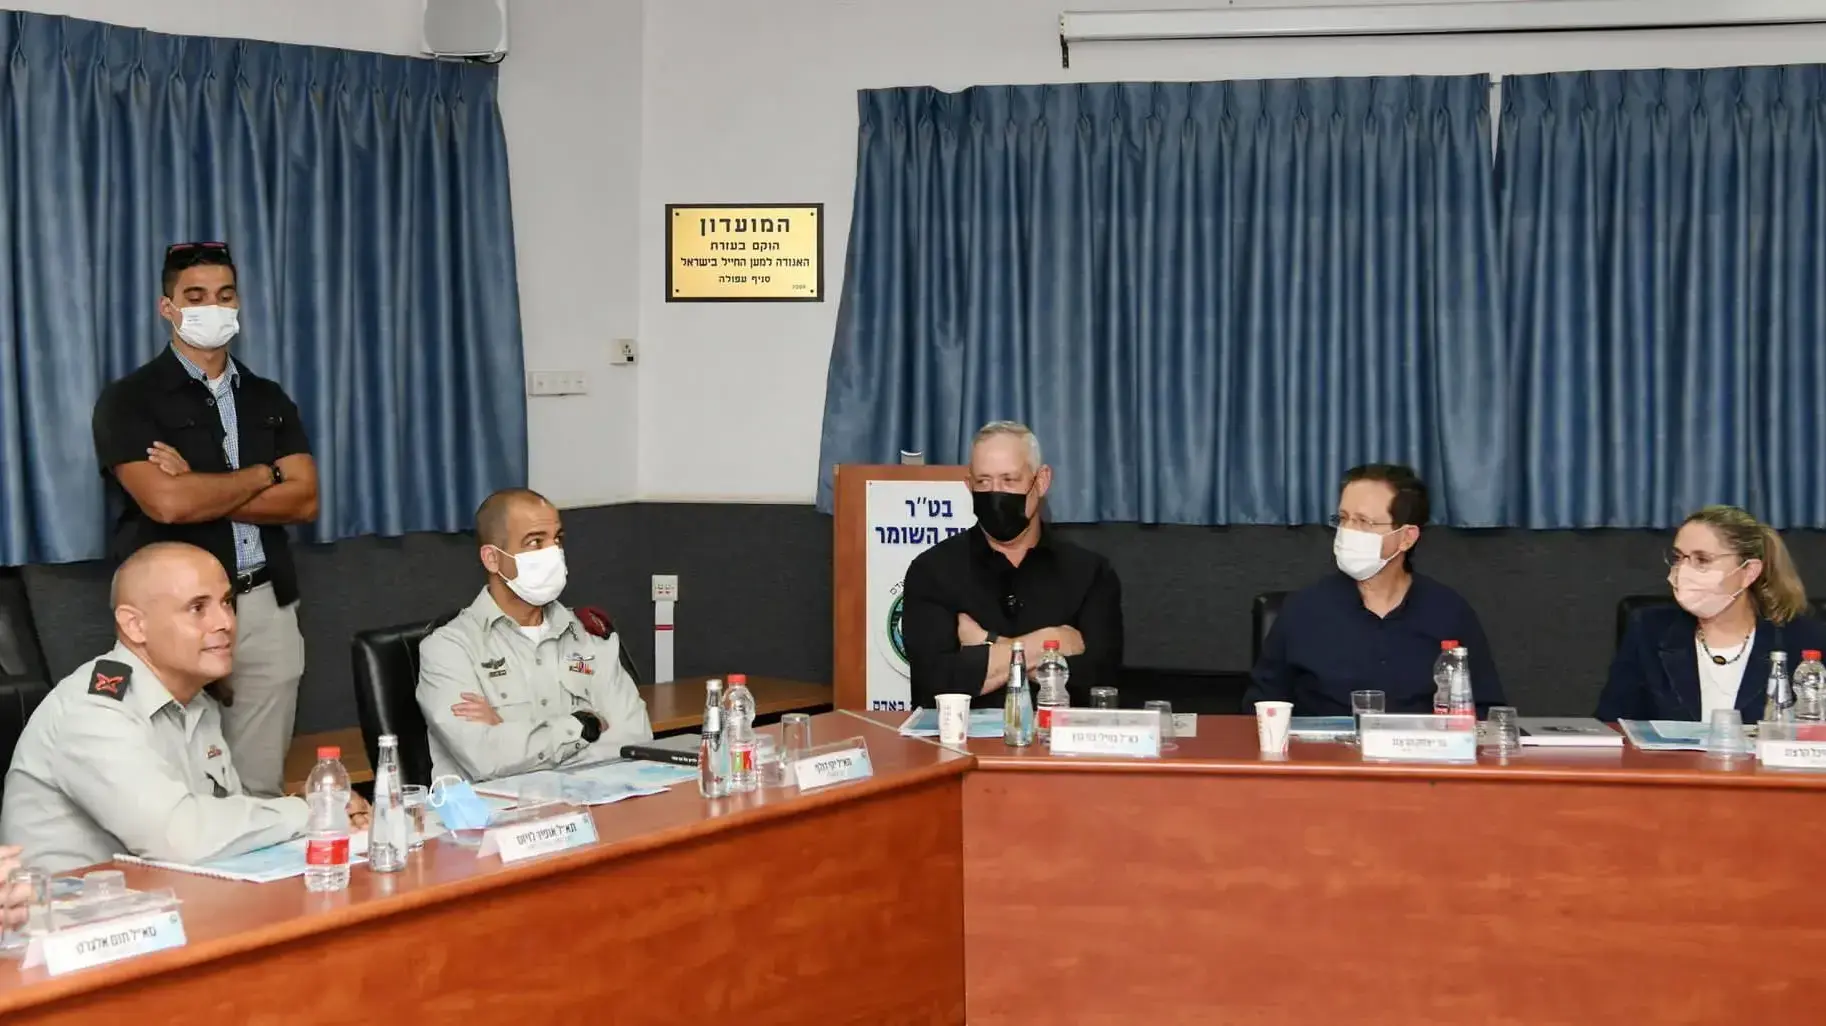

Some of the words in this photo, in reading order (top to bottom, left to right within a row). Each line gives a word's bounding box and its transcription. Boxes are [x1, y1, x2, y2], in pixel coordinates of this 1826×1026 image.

[700, 217, 790, 236] המועדון
[710, 241, 746, 251] בעזרת
[752, 241, 780, 253] הוקם
[680, 257, 718, 267] בישראל
[721, 257, 746, 267] החייל
[750, 257, 772, 269] למען
[776, 258, 810, 267] האגודה
[718, 275, 747, 284] עפולה
[751, 275, 771, 285] סניף
[875, 526, 939, 545] השומר
